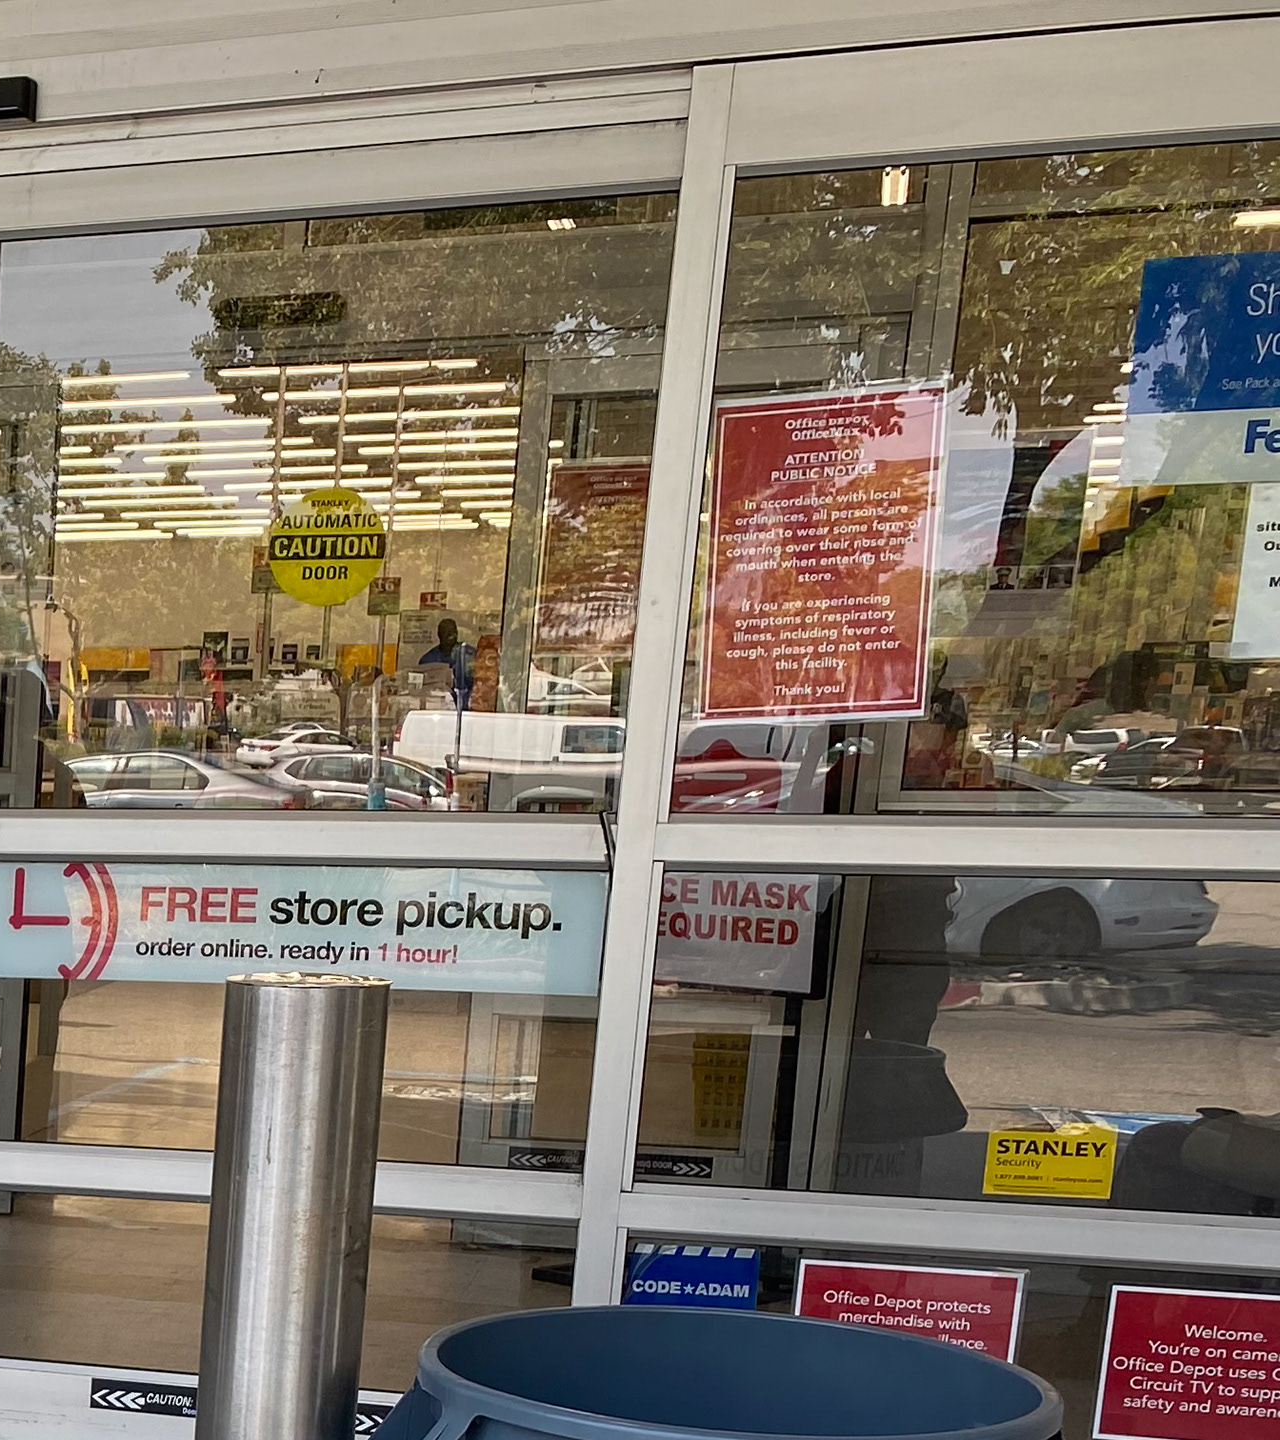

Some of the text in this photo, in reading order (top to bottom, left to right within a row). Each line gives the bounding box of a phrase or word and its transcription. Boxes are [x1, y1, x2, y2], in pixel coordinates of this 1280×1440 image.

[785, 417, 826, 430] Office
[792, 427, 861, 441] OfficeMax
[785, 449, 865, 466] ATTENTION
[771, 462, 877, 482] PUBLIC NOTICE
[281, 513, 377, 529] AUTOMATIC
[274, 535, 378, 557] CAUTION
[302, 566, 348, 580] DOOR
[754, 601, 777, 614] you
[782, 600, 802, 610] are
[807, 594, 891, 610] experiencing
[735, 609, 896, 629] symptoms of respiratory
[733, 625, 895, 643] illness, including fever or
[726, 639, 901, 660] cough, please do not enter
[776, 657, 848, 670] this facility.
[774, 685, 845, 697] Thank you!
[711, 879, 812, 911] MASK
[139, 886, 562, 941] FREE store pickup.
[135, 937, 458, 965] order online. ready in 1 hour!
[997, 1139, 1107, 1157] STANLEY
[996, 1157, 1042, 1169] Security
[631, 1279, 750, 1298] CODE ADAM
[823, 1289, 992, 1316] Office Depot protects
[838, 1310, 971, 1332] merchandise with
[1184, 1324, 1268, 1343] Welcome.
[1148, 1340, 1201, 1357] You're
[1205, 1348, 1227, 1359] on
[1112, 1356, 1266, 1380] Office Depot uses
[1130, 1376, 1184, 1393] Circuit
[1189, 1380, 1213, 1394] TV
[1218, 1384, 1235, 1396] to
[146, 1392, 194, 1408] CAUTION:
[1123, 1394, 1174, 1413] safety
[1179, 1399, 1211, 1413] and
